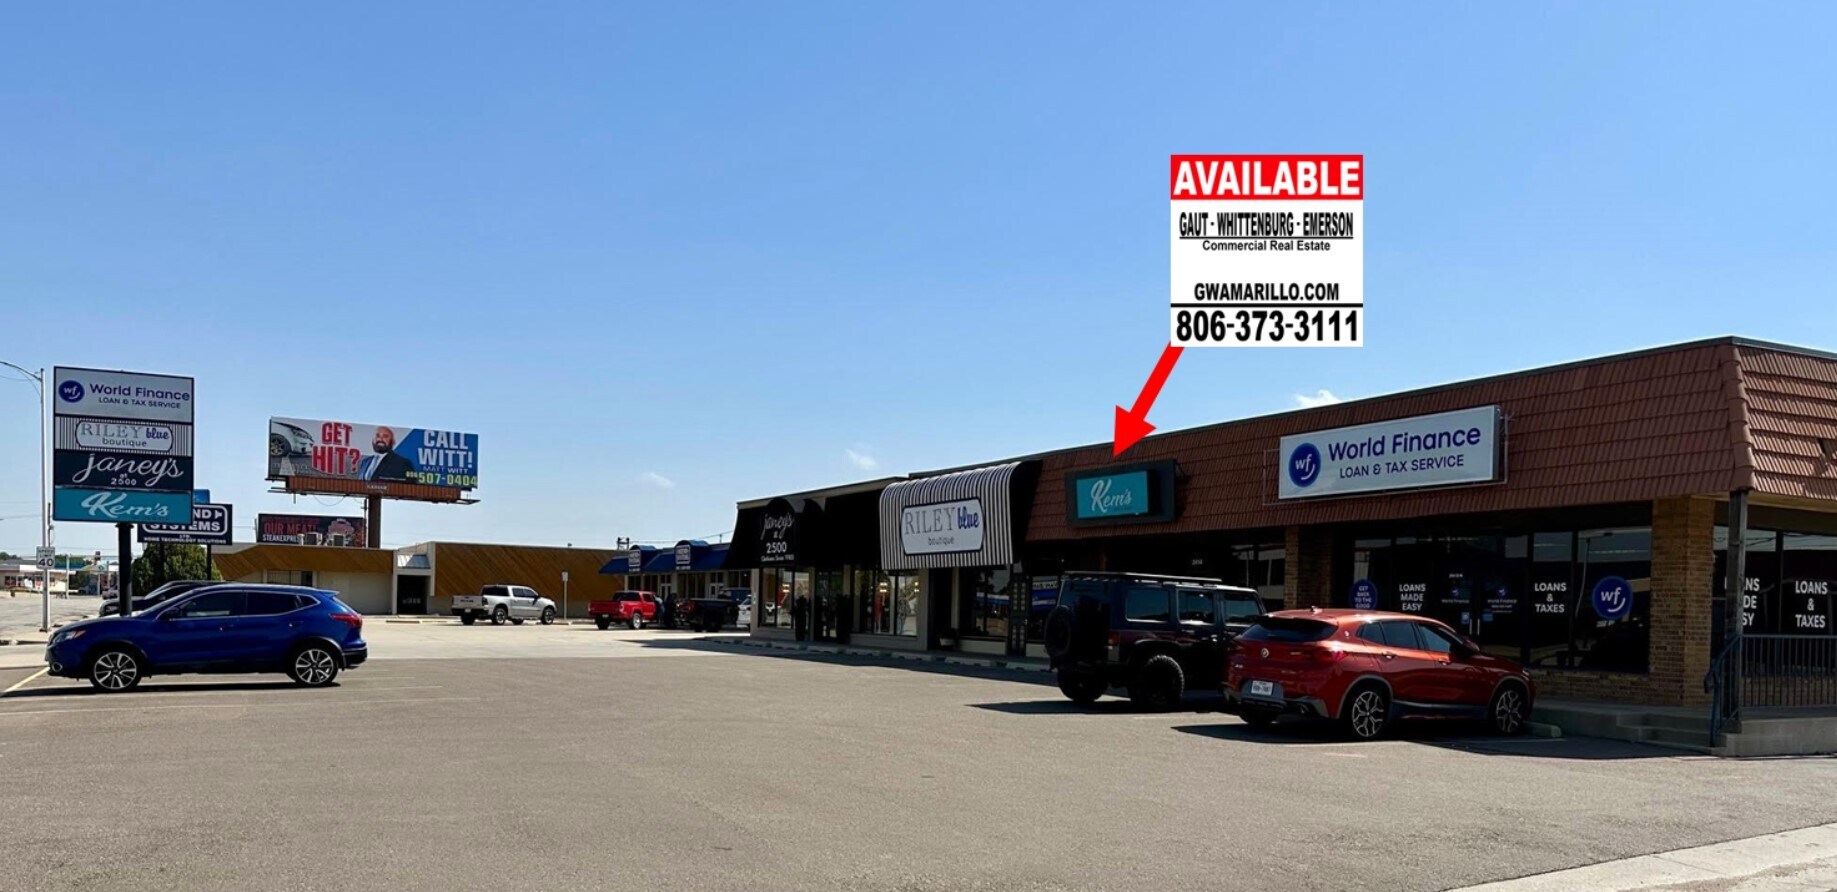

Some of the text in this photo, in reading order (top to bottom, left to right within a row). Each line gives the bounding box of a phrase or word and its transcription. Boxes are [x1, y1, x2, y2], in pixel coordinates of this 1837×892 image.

[63, 386, 78, 396] wf
[90, 383, 190, 401] World Finance
[148, 400, 181, 409] SERVICE
[80, 423, 170, 440] RILEY blue
[322, 422, 352, 446] GET
[102, 438, 148, 448] boutique
[424, 429, 468, 450] CALL
[1328, 428, 1481, 462] World Finance
[312, 445, 361, 475] HIT?
[418, 448, 473, 468] WITT!
[1296, 454, 1312, 472] wf
[1340, 454, 1464, 479] LOAN & TAX SERVICE
[111, 478, 137, 486] 2500
[1091, 478, 1132, 513] Kem's
[81, 491, 168, 518] Kem's
[904, 506, 980, 535] RILEY blue
[264, 522, 284, 535] OUR
[287, 523, 317, 535] MEAT!
[766, 541, 788, 554] 2500
[928, 537, 954, 548] boutique
[38, 558, 54, 566] 40
[1398, 584, 1426, 592] LOANS
[1534, 582, 1567, 592] LOANS
[1795, 580, 1828, 594] LOANS
[1400, 593, 1424, 602] MADE
[1546, 593, 1554, 602] &
[1600, 586, 1622, 605] wf
[1402, 602, 1422, 611] EASY
[1535, 604, 1565, 613] TAXES
[1807, 598, 1814, 611] &
[1795, 614, 1826, 628] TAXES
